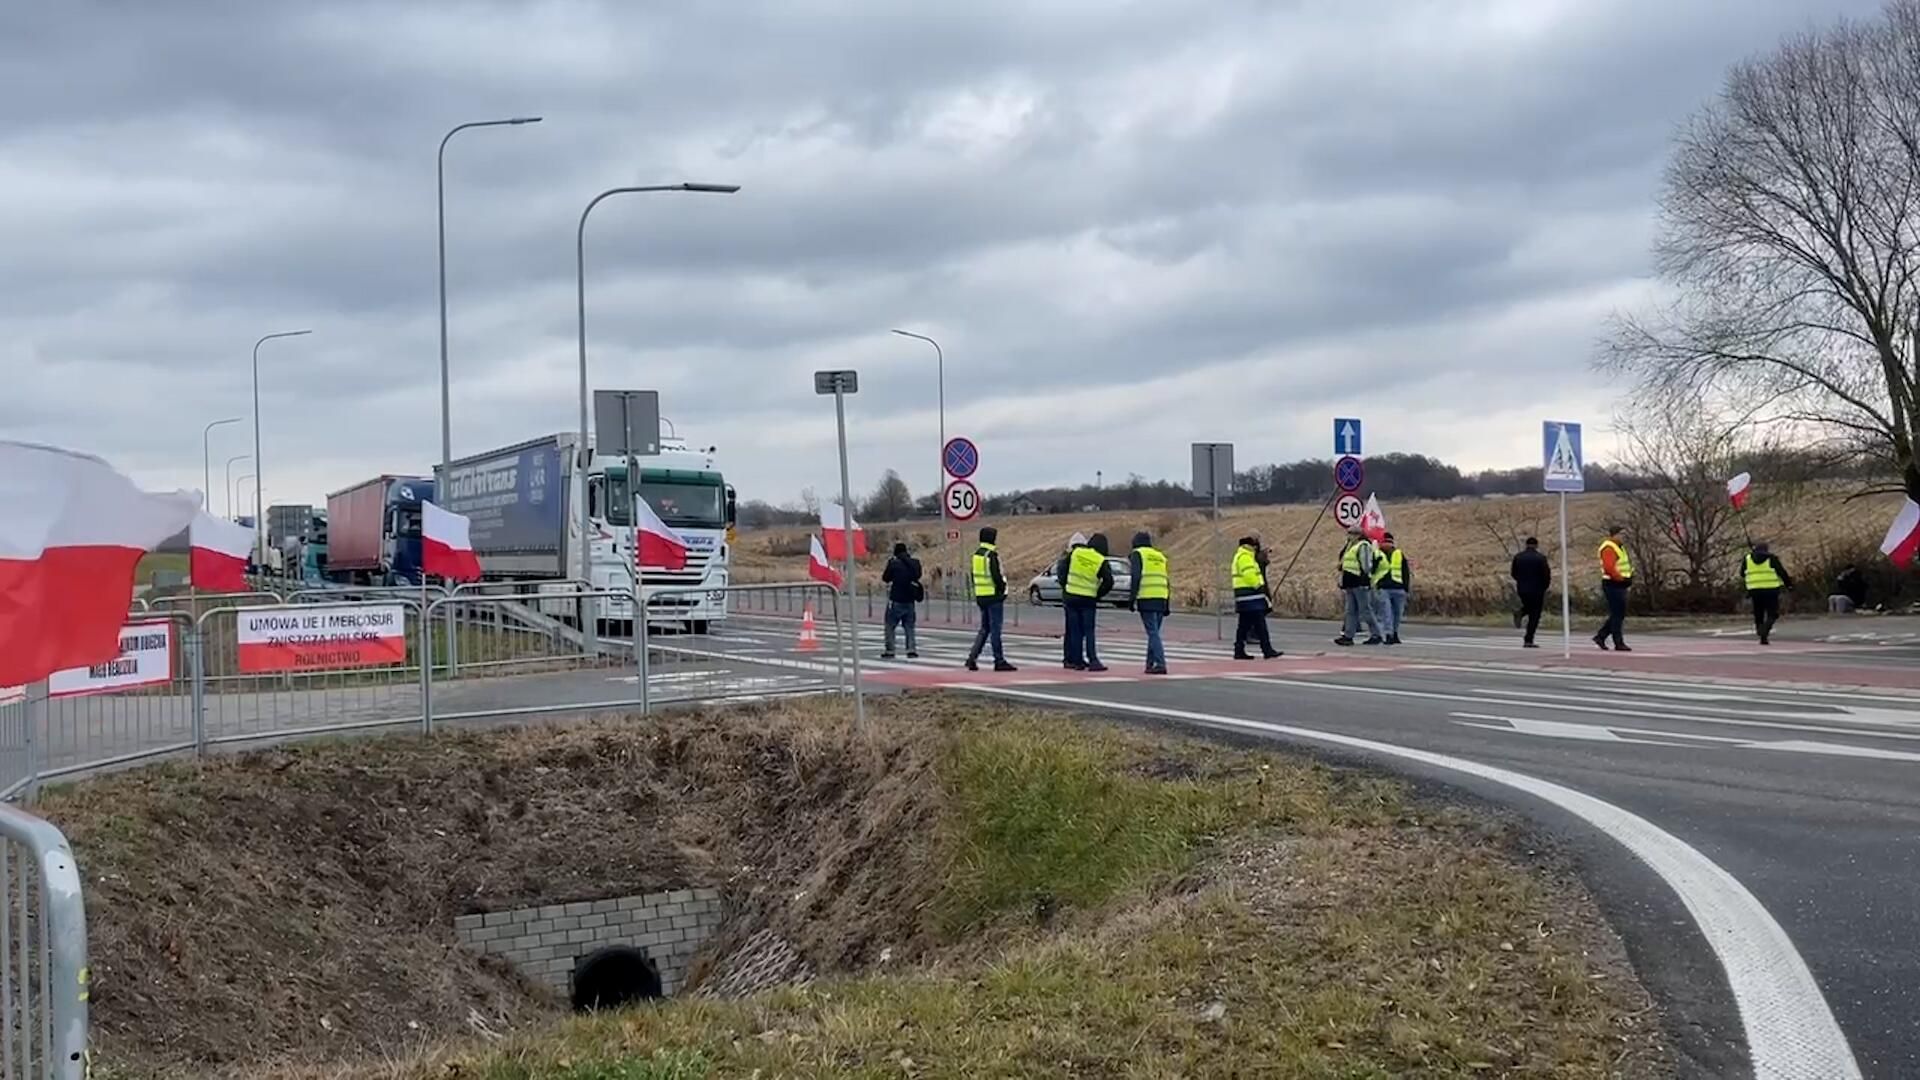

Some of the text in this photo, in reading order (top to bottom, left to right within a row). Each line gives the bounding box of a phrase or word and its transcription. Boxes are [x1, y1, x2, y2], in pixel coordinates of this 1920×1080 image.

[951, 491, 974, 510] 50
[1340, 502, 1360, 519] 50
[250, 617, 298, 631] UMOWA
[302, 616, 318, 629] UE
[329, 613, 394, 628] MERCOSUR
[331, 631, 380, 646] POLSKIE
[294, 651, 361, 666] ROLNICTWO
